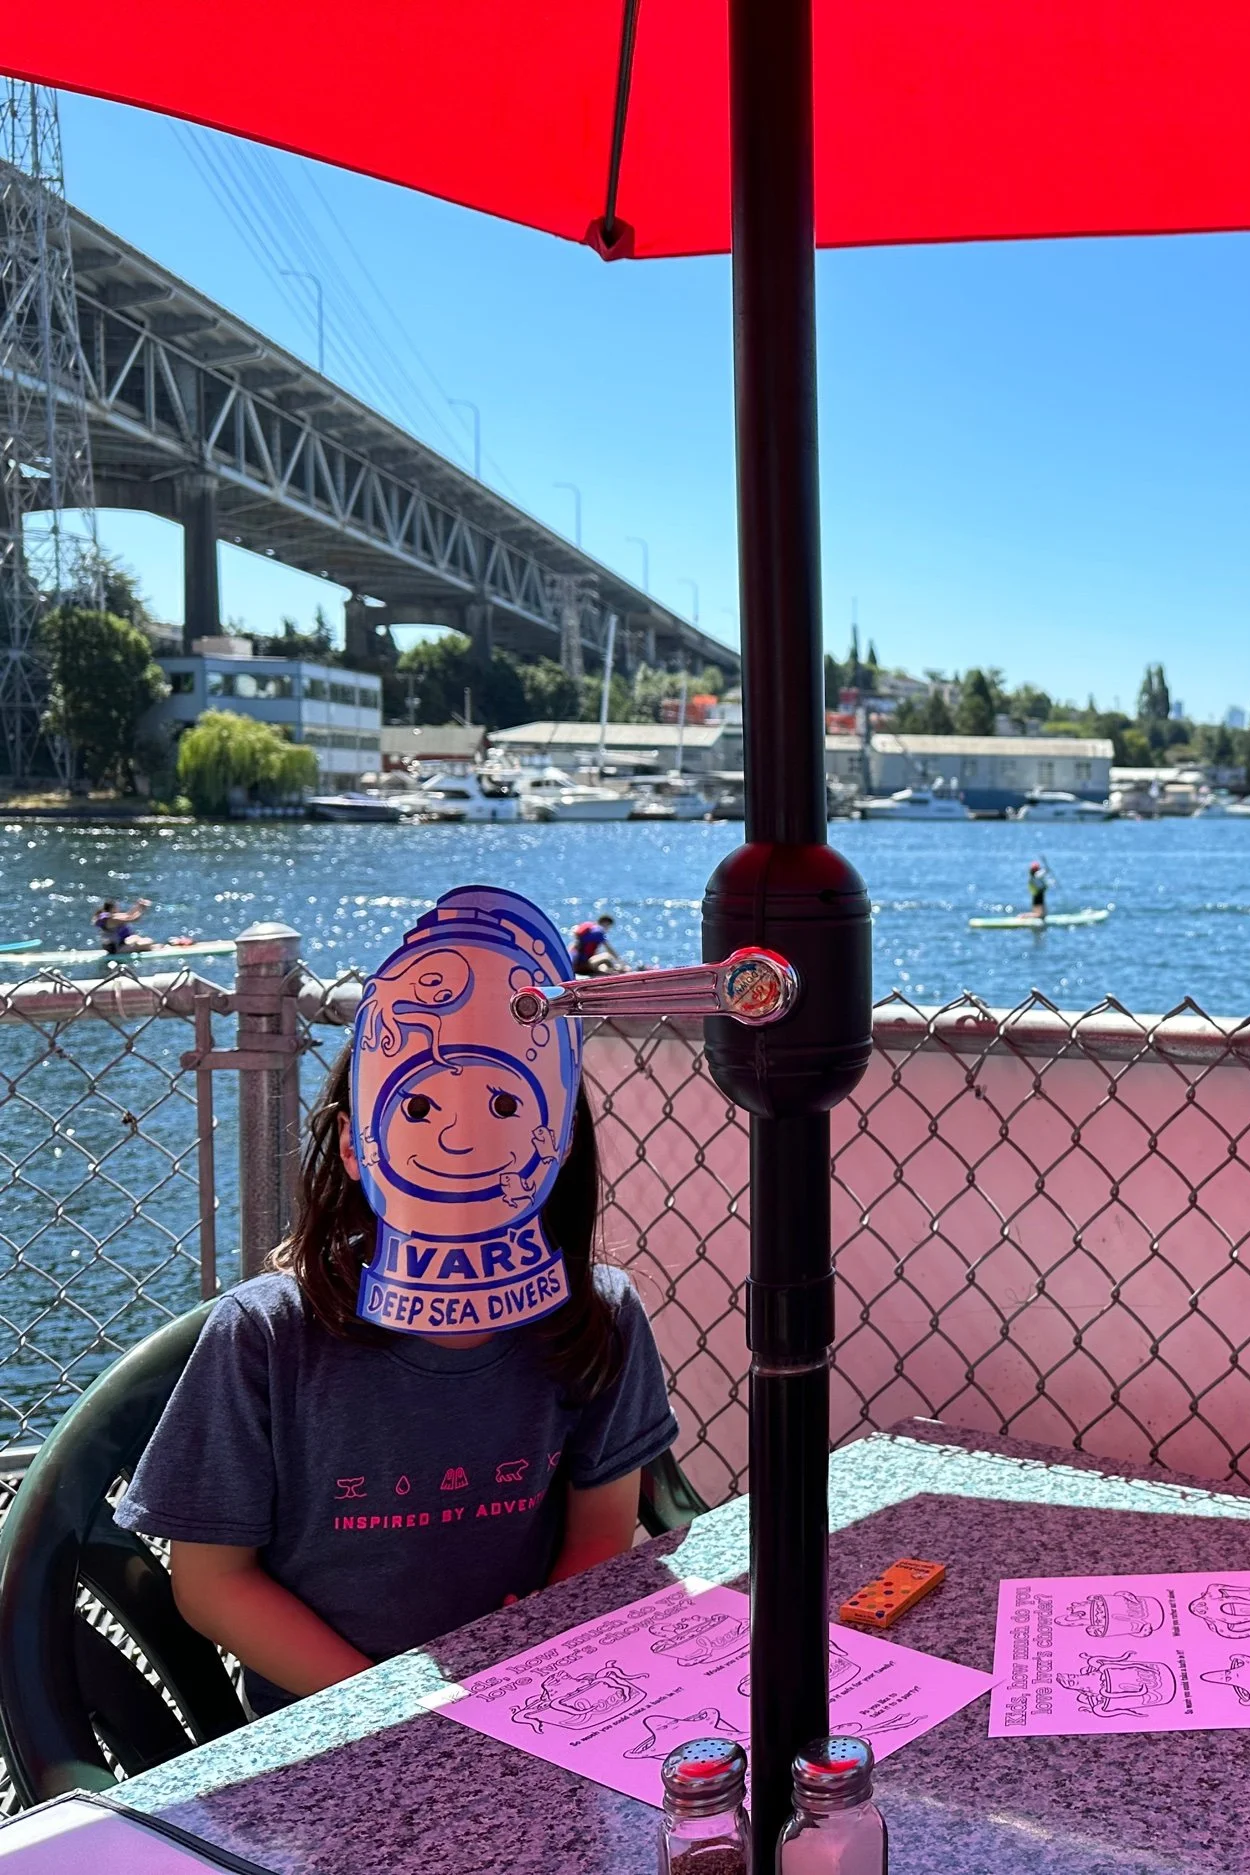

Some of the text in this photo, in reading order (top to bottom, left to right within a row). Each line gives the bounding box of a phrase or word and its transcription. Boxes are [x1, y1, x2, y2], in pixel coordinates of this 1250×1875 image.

[386, 1229, 542, 1279] IVAR'S
[368, 1269, 561, 1326] DEEP SEA DIVERS
[334, 1512, 430, 1530] INSPIRED
[441, 1507, 465, 1523] BY
[476, 1600, 696, 1702] love Ivar's chowder?
[506, 1648, 559, 1674] how
[561, 1620, 628, 1649] much
[627, 1606, 656, 1619] do
[655, 1591, 688, 1606] yo
[1005, 1586, 1036, 1727] Kids, how much do you
[1031, 1594, 1053, 1715] love Ivar's chowder?
